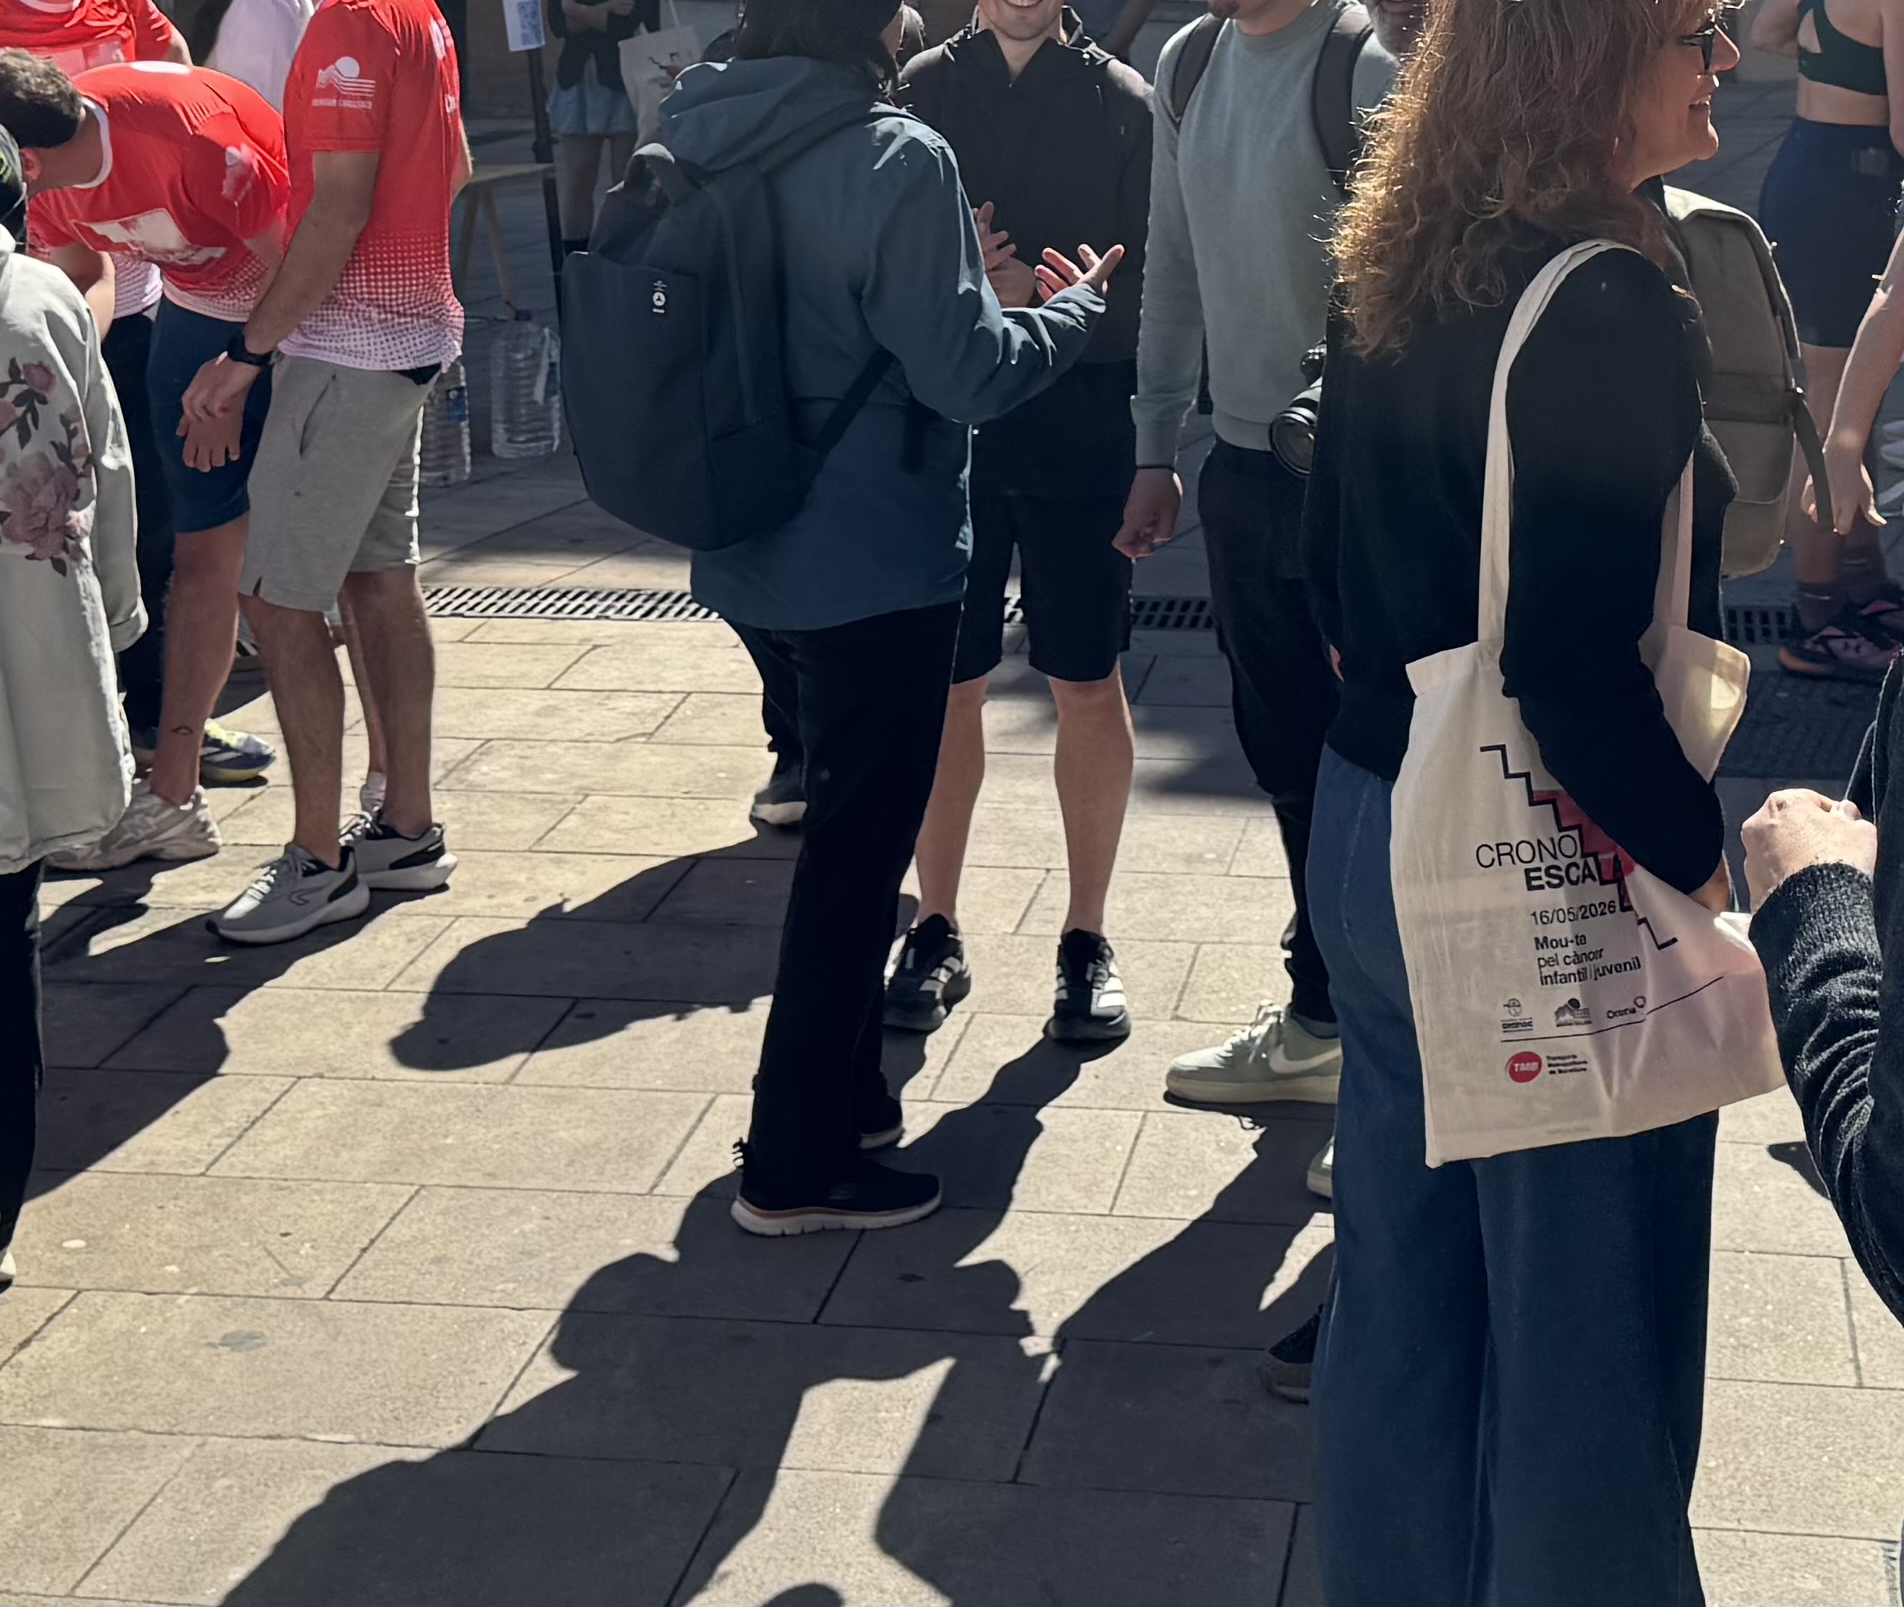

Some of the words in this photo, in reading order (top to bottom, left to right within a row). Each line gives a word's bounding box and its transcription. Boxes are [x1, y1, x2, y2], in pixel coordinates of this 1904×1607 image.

[1475, 834, 1578, 869] CRONO
[1530, 900, 1617, 926] 16/05/2026
[1534, 933, 1587, 951] Mou-te
[1537, 954, 1560, 971] pel
